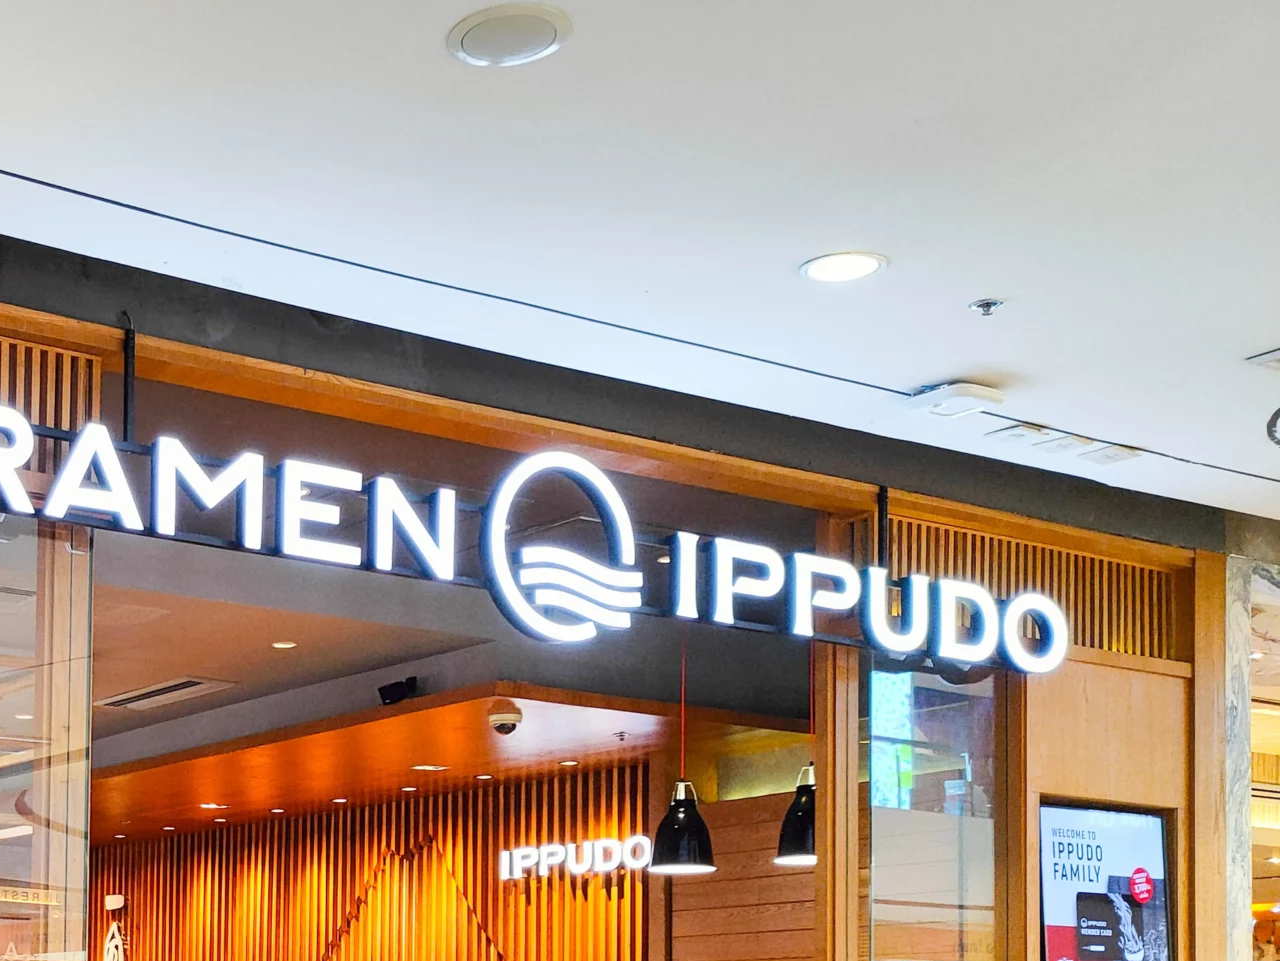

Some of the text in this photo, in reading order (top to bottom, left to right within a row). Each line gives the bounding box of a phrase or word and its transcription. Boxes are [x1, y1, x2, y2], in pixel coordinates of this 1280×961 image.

[674, 528, 1070, 677] IPPUDO
[1051, 828, 1096, 841] WELCOME TO
[500, 835, 651, 880] IPPUDO
[1052, 841, 1103, 862] IPPUDO
[1053, 862, 1101, 883] FAMILY
